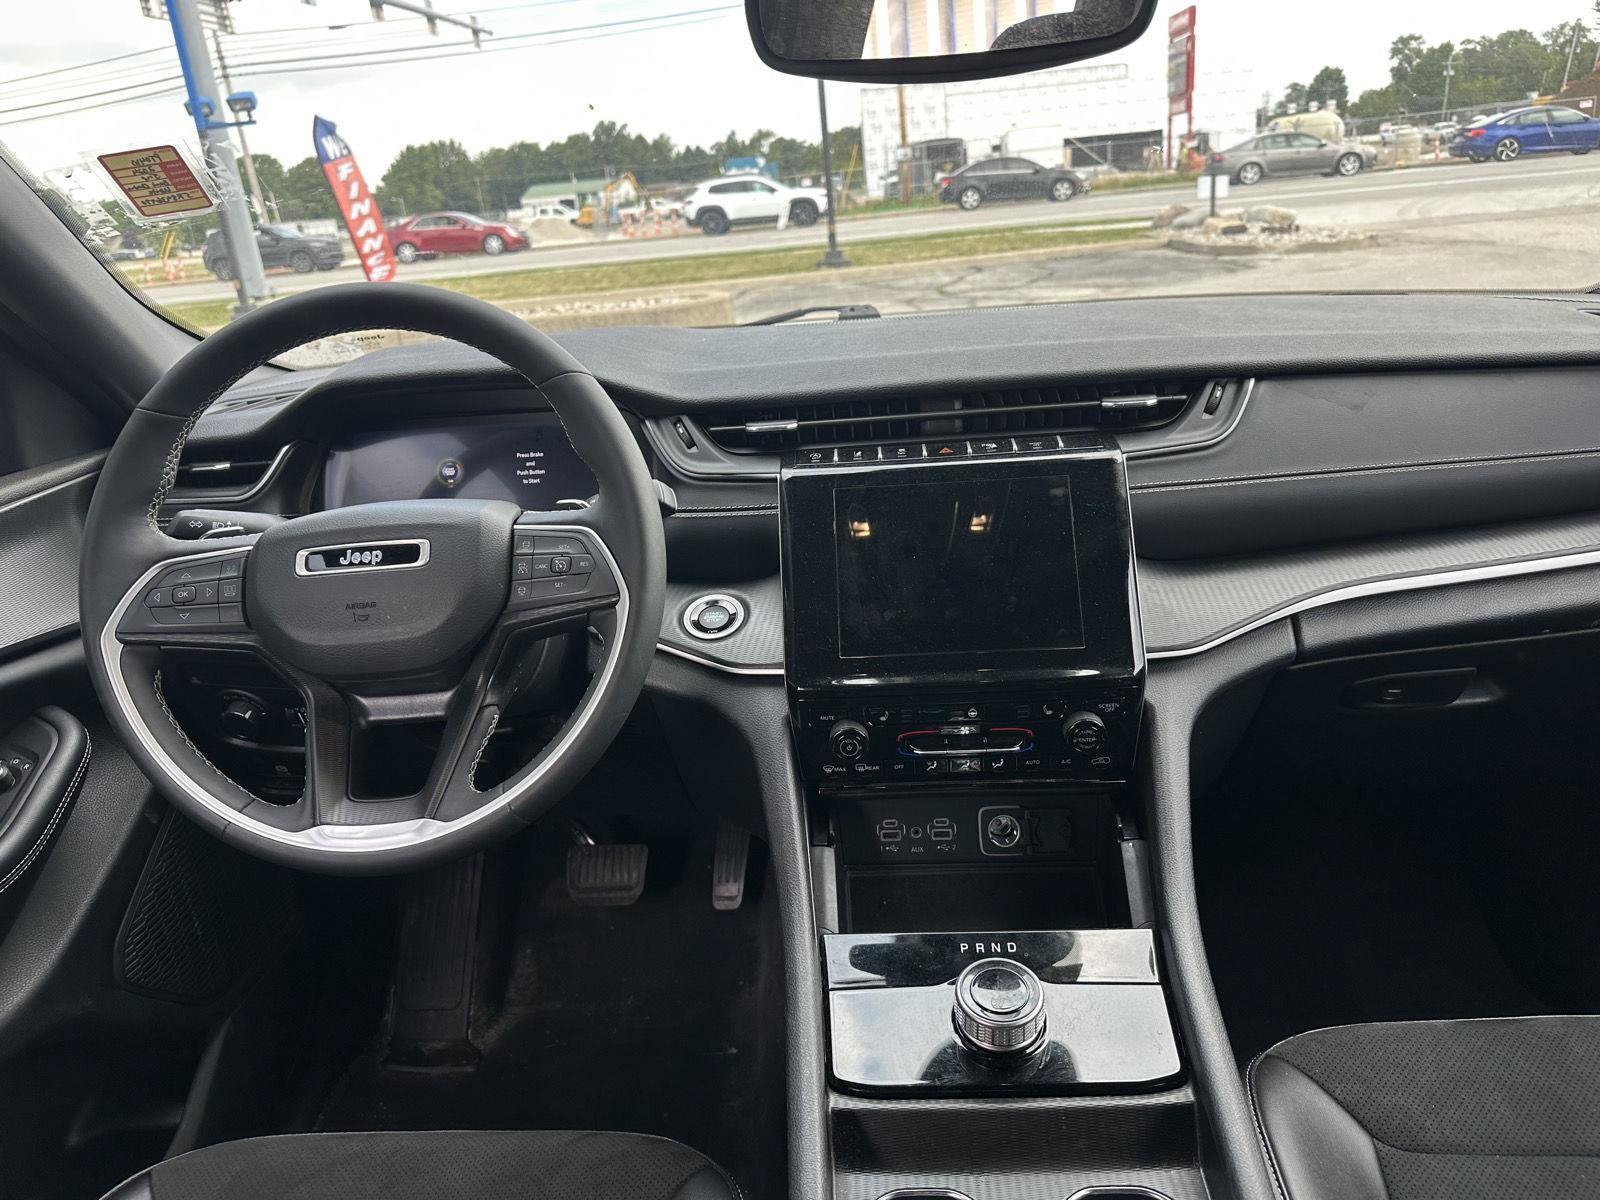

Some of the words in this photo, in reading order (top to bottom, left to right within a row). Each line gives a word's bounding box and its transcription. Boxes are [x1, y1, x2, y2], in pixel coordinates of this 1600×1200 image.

[336, 161, 391, 281] FINANCE
[339, 549, 383, 566] Jeep
[345, 601, 377, 610] AIRBAG
